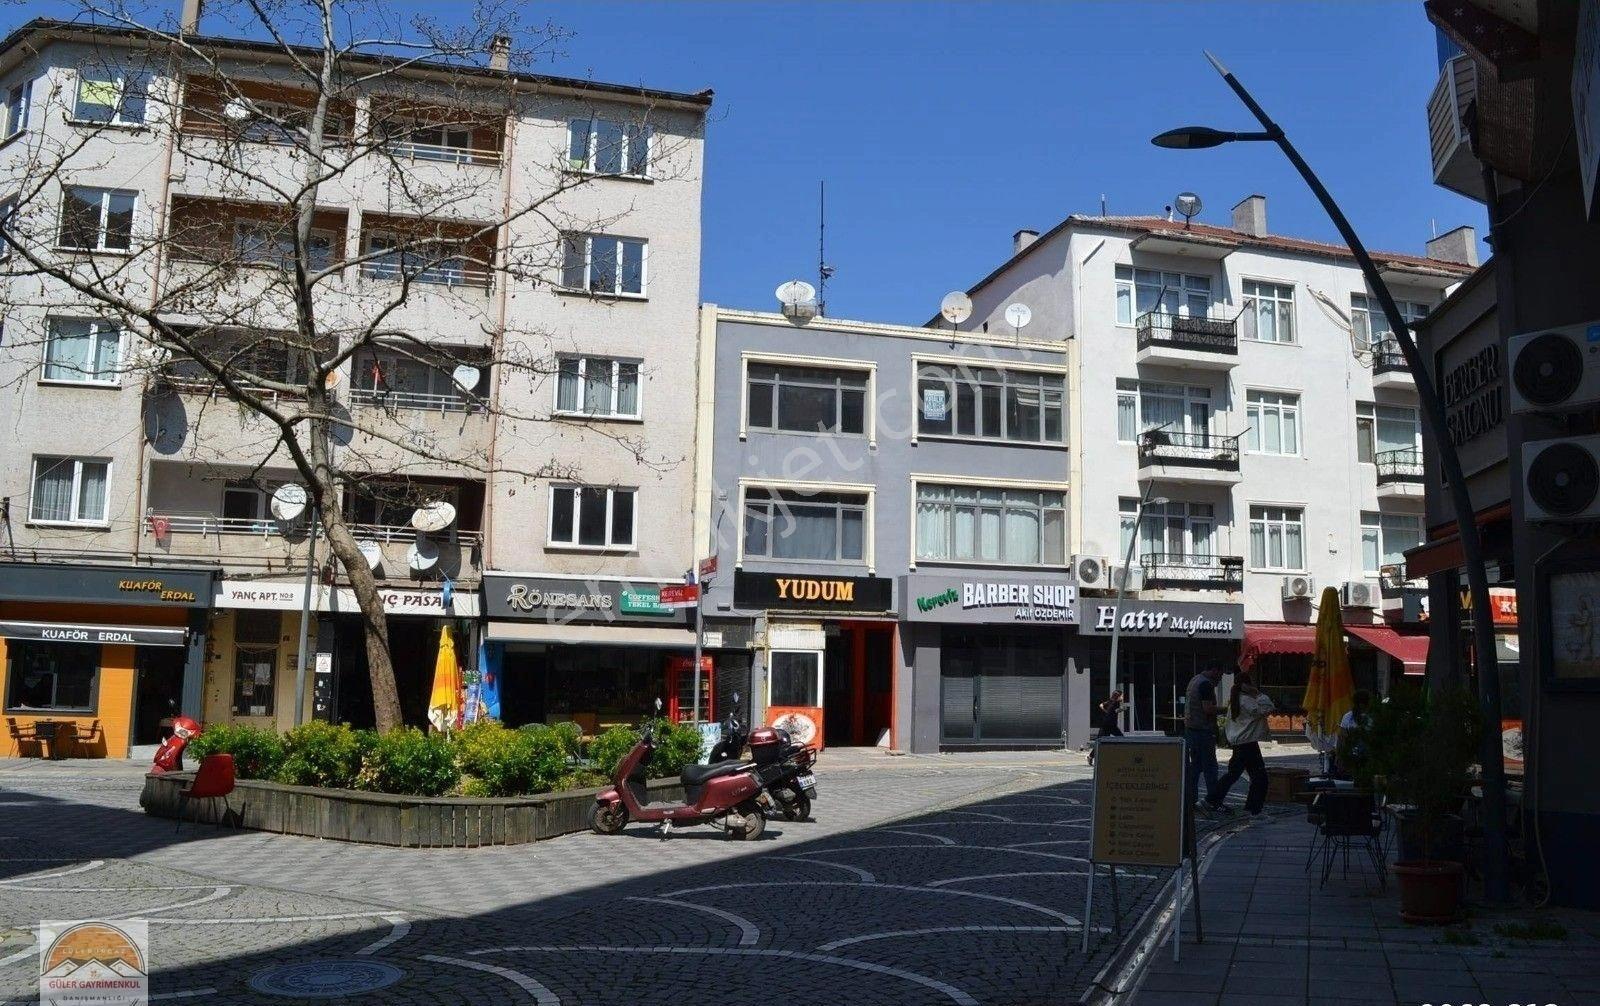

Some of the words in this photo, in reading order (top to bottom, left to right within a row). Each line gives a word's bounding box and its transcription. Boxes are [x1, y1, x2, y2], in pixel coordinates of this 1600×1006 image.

[1443, 343, 1500, 409] BERBER
[1446, 384, 1504, 447] SALONU
[118, 579, 163, 590] KUAFÖR
[160, 589, 196, 601] ERDAL
[776, 578, 855, 601] YUDUM
[962, 582, 1030, 608] BARBER
[1033, 585, 1076, 607] SHOP
[231, 590, 257, 603] YANÇ
[1095, 605, 1169, 629] Hatır
[1169, 614, 1233, 635] Meyhanesi
[42, 629, 88, 640] KUAFÖR
[98, 632, 135, 642] ERDAL
